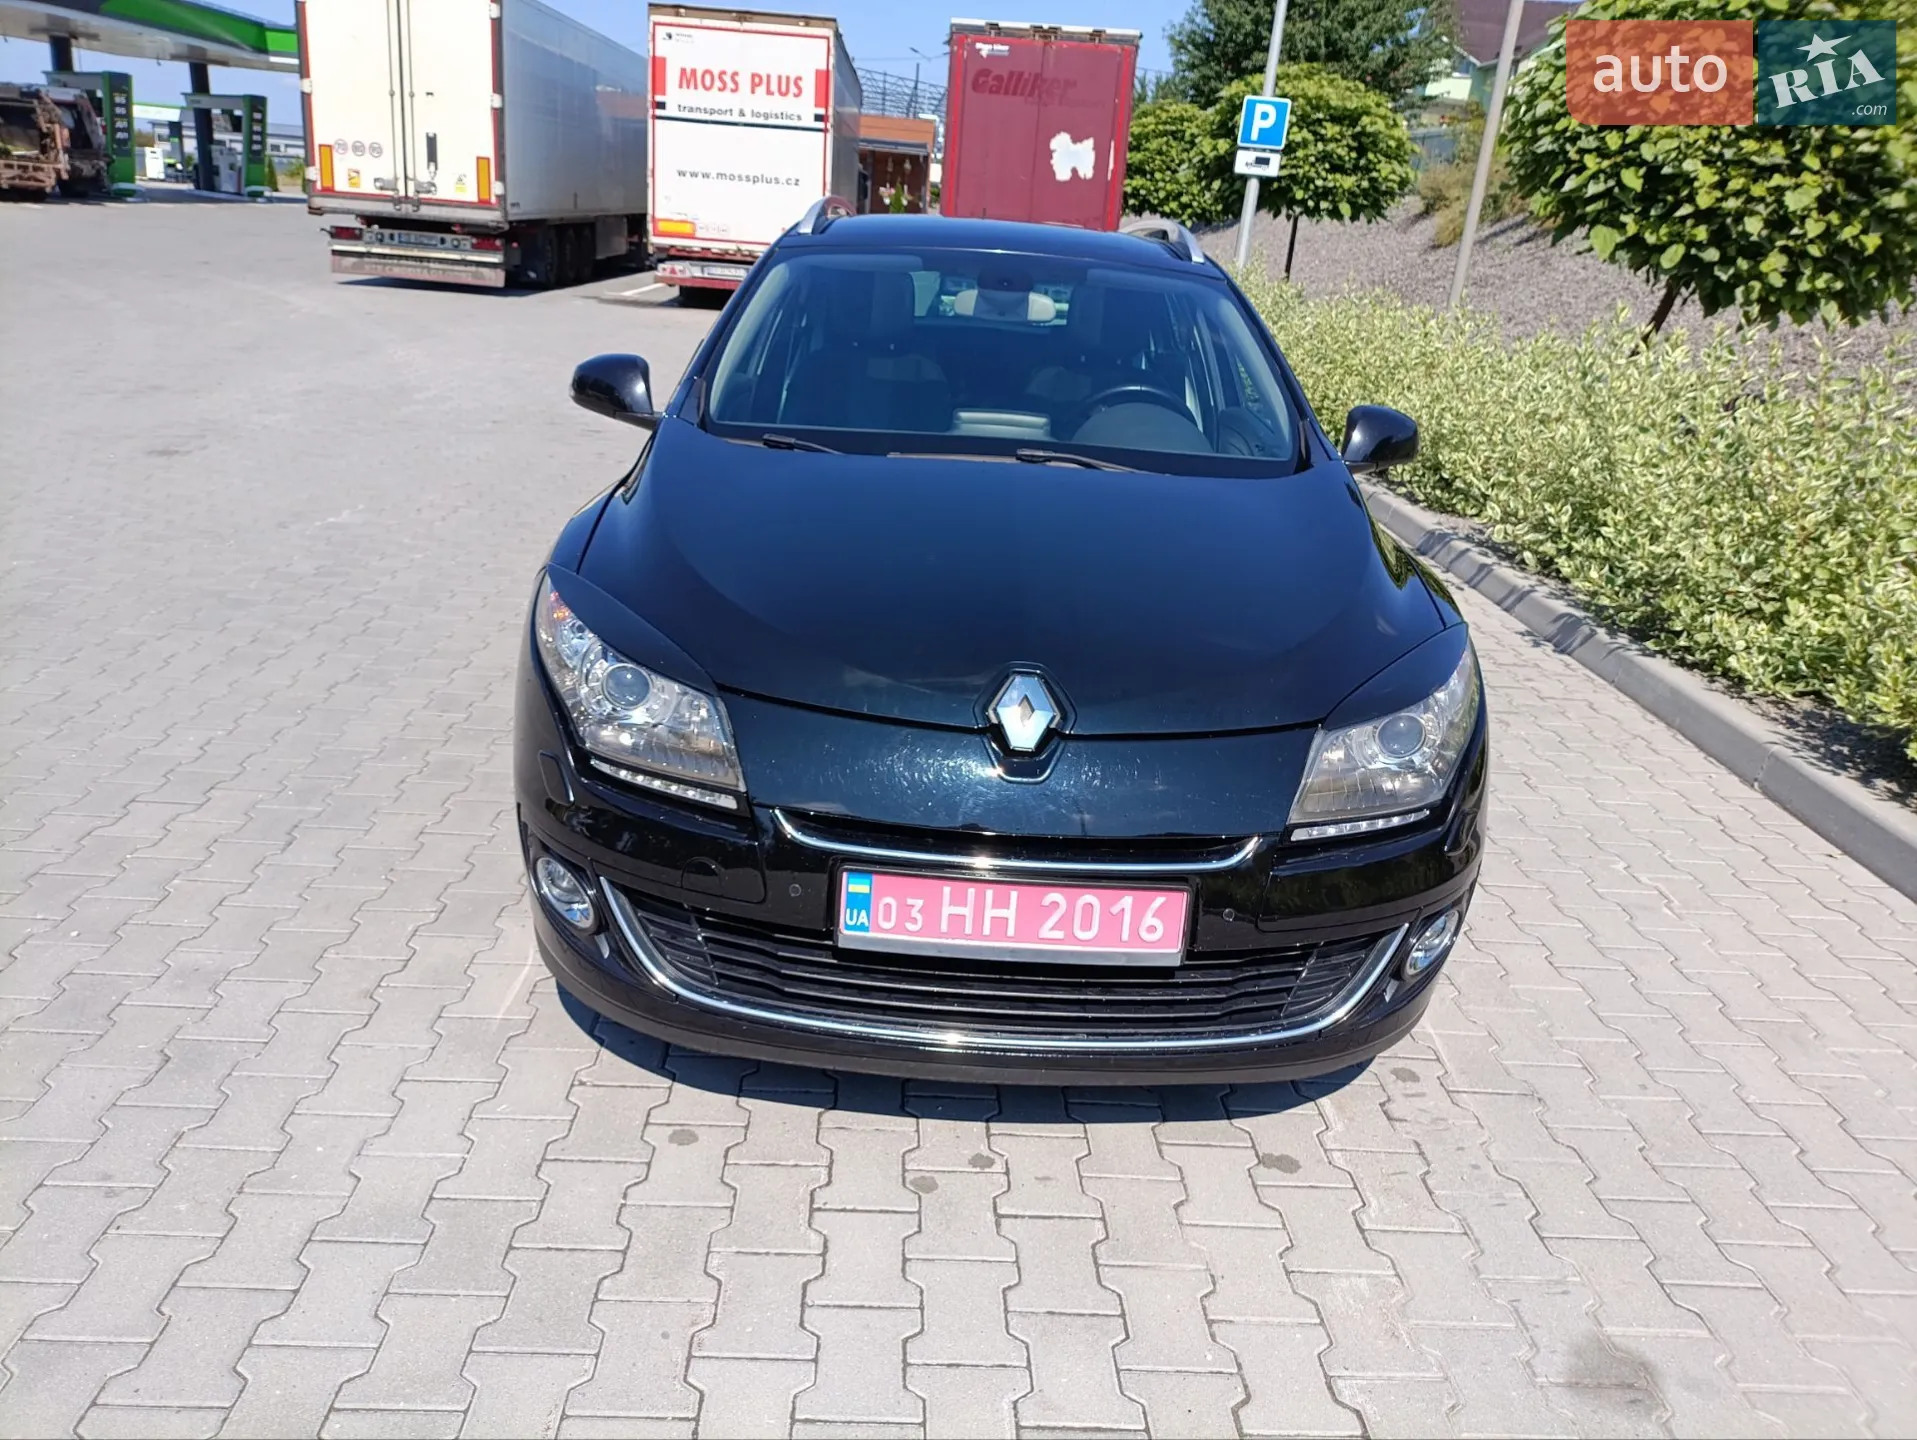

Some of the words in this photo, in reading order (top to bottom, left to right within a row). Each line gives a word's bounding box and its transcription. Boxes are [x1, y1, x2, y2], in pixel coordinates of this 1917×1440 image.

[678, 67, 740, 93] MOSS
[750, 72, 804, 99] PLUS
[677, 103, 734, 117] transport
[738, 108, 746, 118] &
[751, 109, 803, 122] logistics
[1250, 102, 1277, 142] P
[676, 168, 800, 187] www.mossplus.cz
[845, 908, 869, 927] UA
[877, 896, 925, 933] 03
[940, 886, 1018, 937] HH
[1038, 892, 1167, 943] 2016
